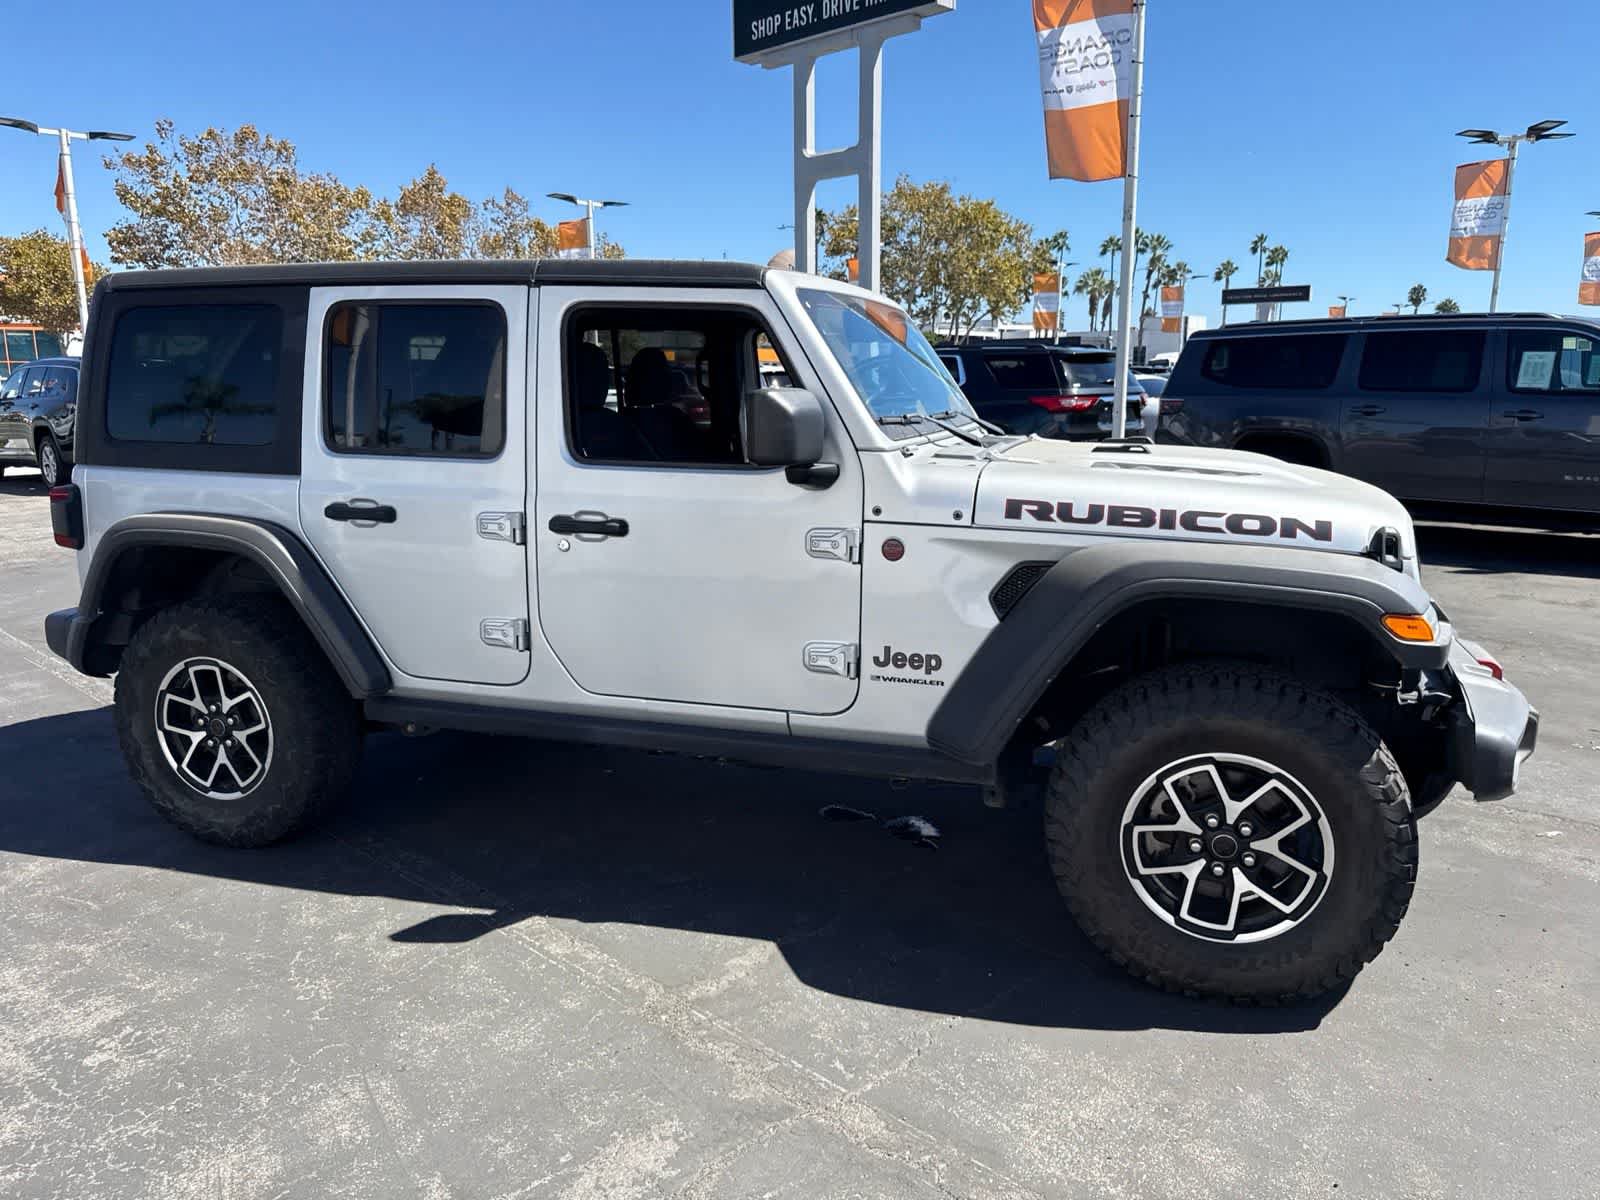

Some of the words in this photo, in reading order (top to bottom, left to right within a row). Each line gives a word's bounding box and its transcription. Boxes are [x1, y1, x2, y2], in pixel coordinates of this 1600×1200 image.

[751, 18, 781, 41] SHOP
[785, 6, 817, 30] EASY.
[1004, 498, 1332, 542] RUBICON
[872, 645, 942, 675] Jeep
[882, 675, 944, 687] WRANGLER
